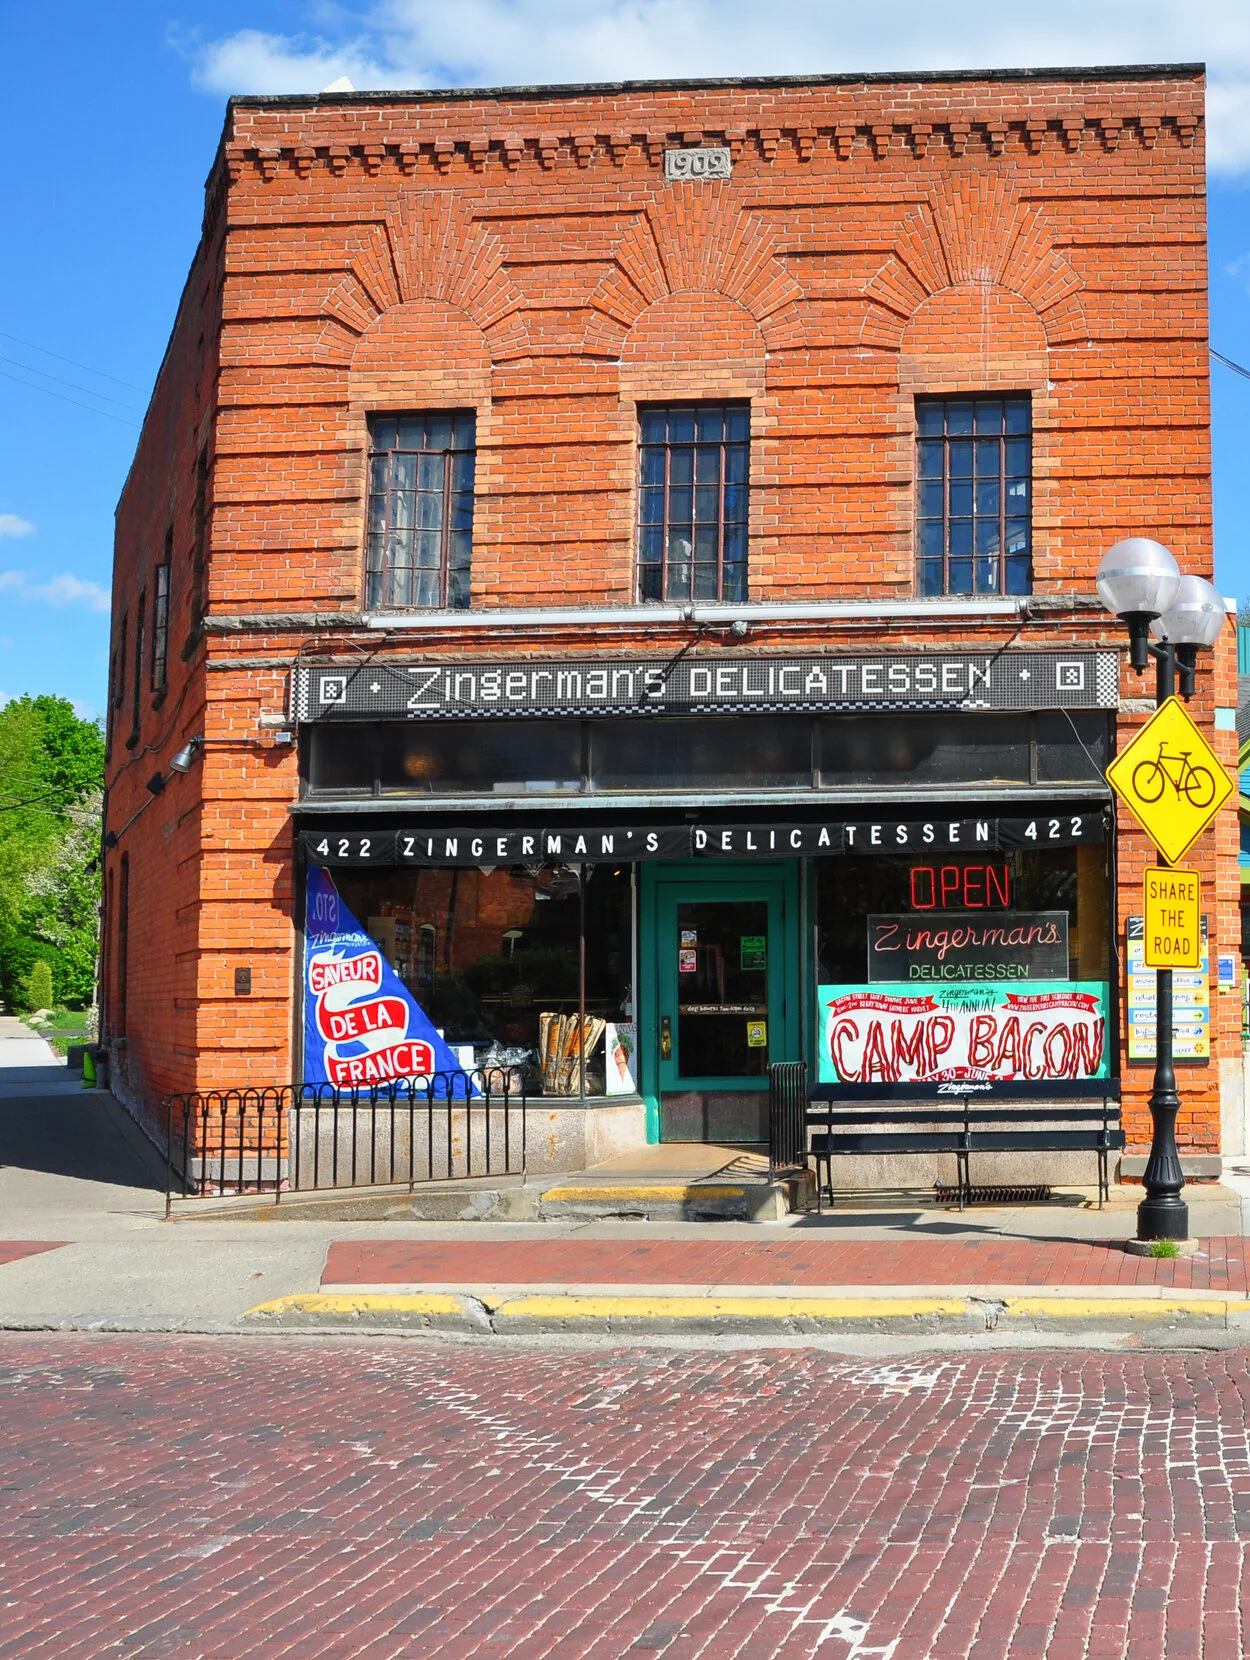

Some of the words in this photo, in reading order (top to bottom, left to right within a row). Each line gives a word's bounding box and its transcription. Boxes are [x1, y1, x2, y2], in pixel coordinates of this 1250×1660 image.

[668, 153, 725, 176] 1902
[407, 665, 666, 708] Zingerman's
[690, 660, 991, 697] DELICATESSEN
[316, 838, 371, 857] 422
[403, 830, 660, 857] ZINGERMAN'S
[695, 822, 989, 850] DELICATESSEN
[1024, 816, 1083, 841] 422
[910, 865, 1009, 908] OPEN
[1150, 881, 1195, 901] SHARE
[1160, 909, 1185, 928] THE
[874, 922, 1062, 960] Zingerman's
[1153, 936, 1191, 955] ROAD
[312, 957, 377, 989] SAVEUR
[909, 963, 1030, 979] DELICATESSEN
[921, 997, 927, 1005] 2
[959, 999, 997, 1014] ANNUAL
[329, 1012, 359, 1039] DE
[362, 1003, 393, 1030] LA
[830, 1015, 955, 1082] CAMP
[968, 1015, 1105, 1081] BACON
[335, 1045, 426, 1085] FRANCE
